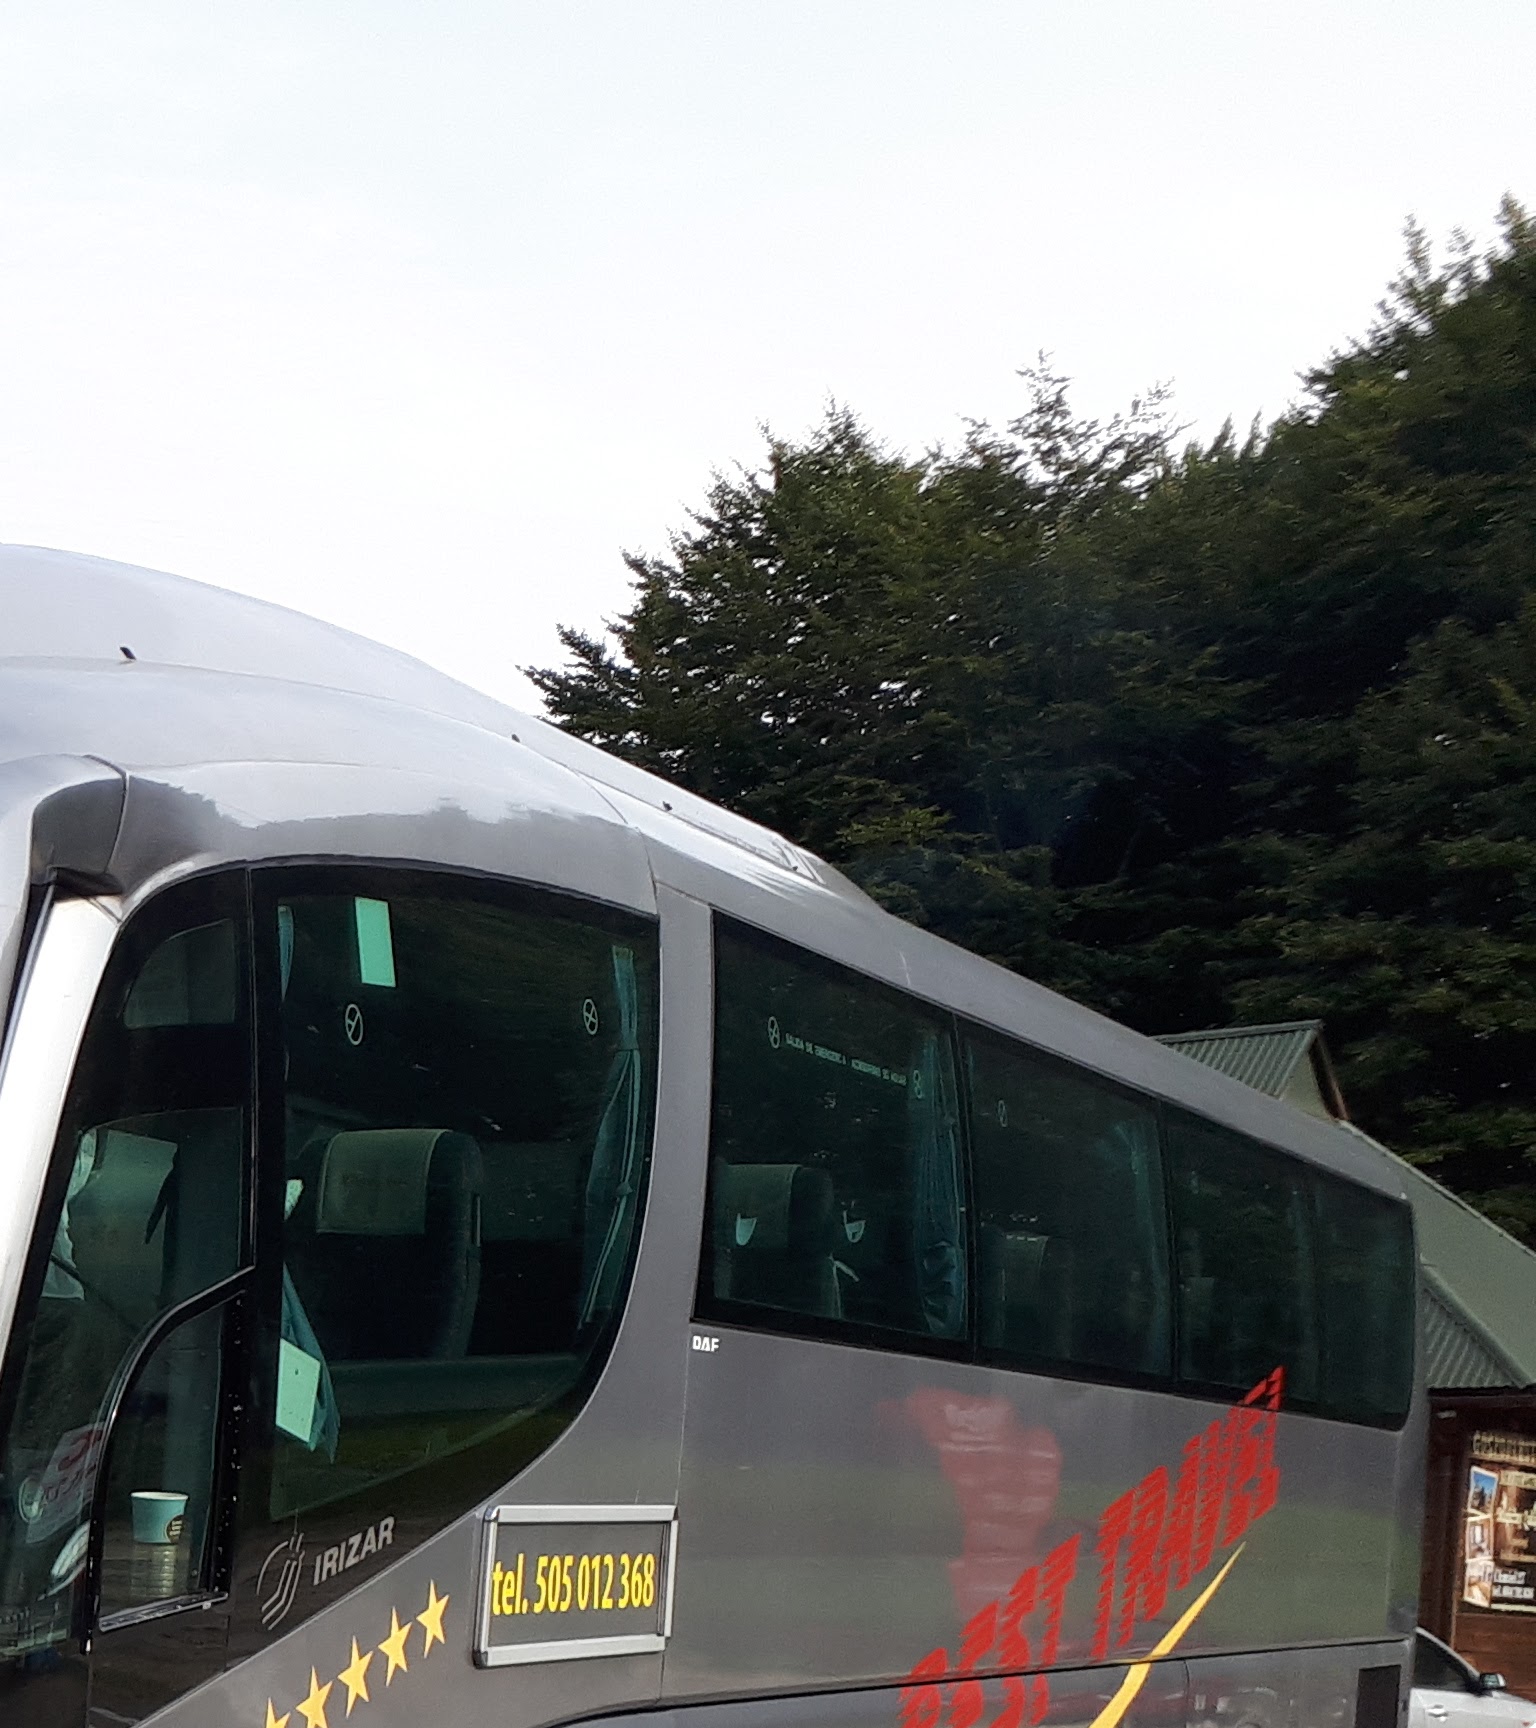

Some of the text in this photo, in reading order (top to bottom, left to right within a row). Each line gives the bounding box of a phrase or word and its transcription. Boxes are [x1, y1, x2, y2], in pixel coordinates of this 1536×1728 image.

[692, 1335, 720, 1352] DAF
[313, 1515, 396, 1587] IRIZAR
[492, 1552, 656, 1616] tel. 505 012 368
